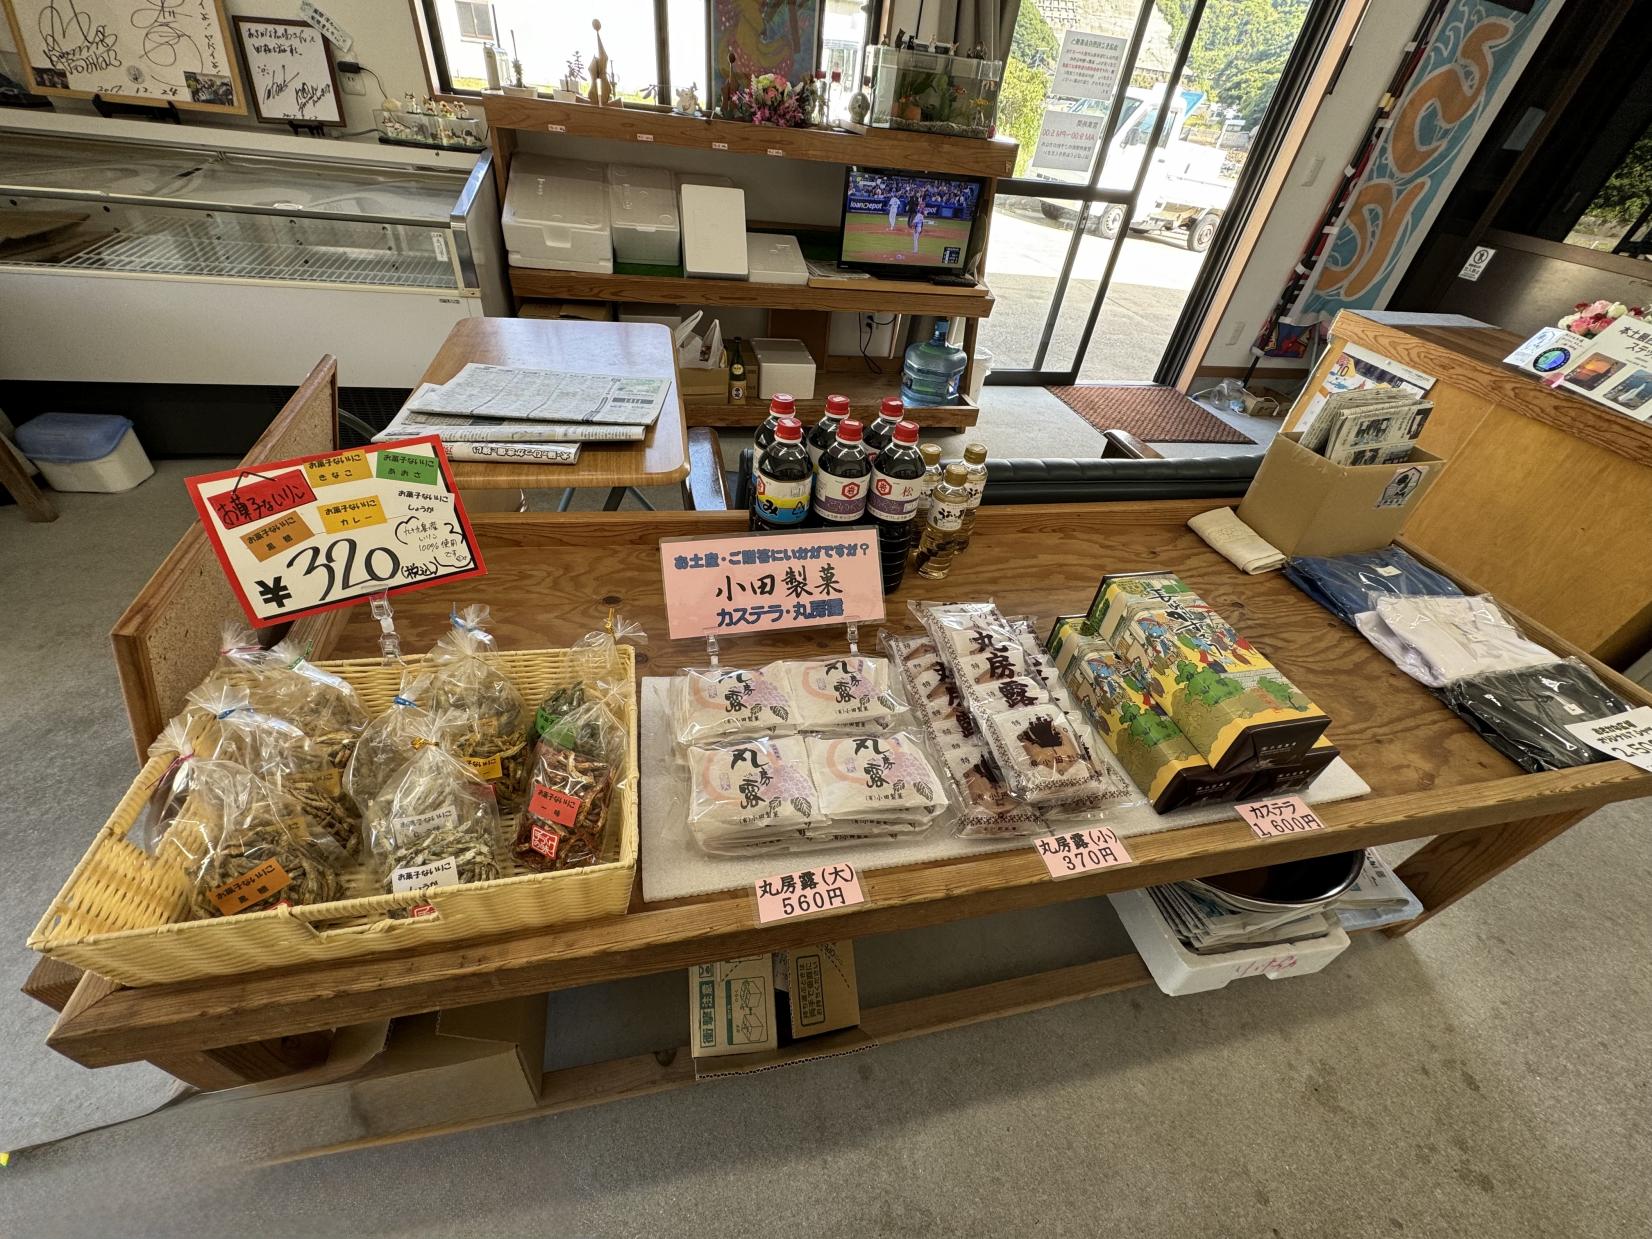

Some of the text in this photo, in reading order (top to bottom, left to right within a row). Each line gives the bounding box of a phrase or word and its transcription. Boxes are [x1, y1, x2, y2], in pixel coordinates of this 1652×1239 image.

[850, 201, 882, 210] loanDepot
[319, 469, 352, 481] きなこ
[388, 468, 421, 478] あおさ
[340, 515, 372, 526] カレー
[715, 562, 843, 601] 小田製菓
[717, 598, 844, 627] カステラ・丸房露
[1249, 801, 1296, 819] カステラ
[1253, 813, 1322, 837] 1,600円
[1039, 827, 1118, 855] 丸房露(小)
[1062, 846, 1119, 871] 370円
[758, 863, 854, 898] 丸房露(大)
[782, 887, 846, 915] 560円
